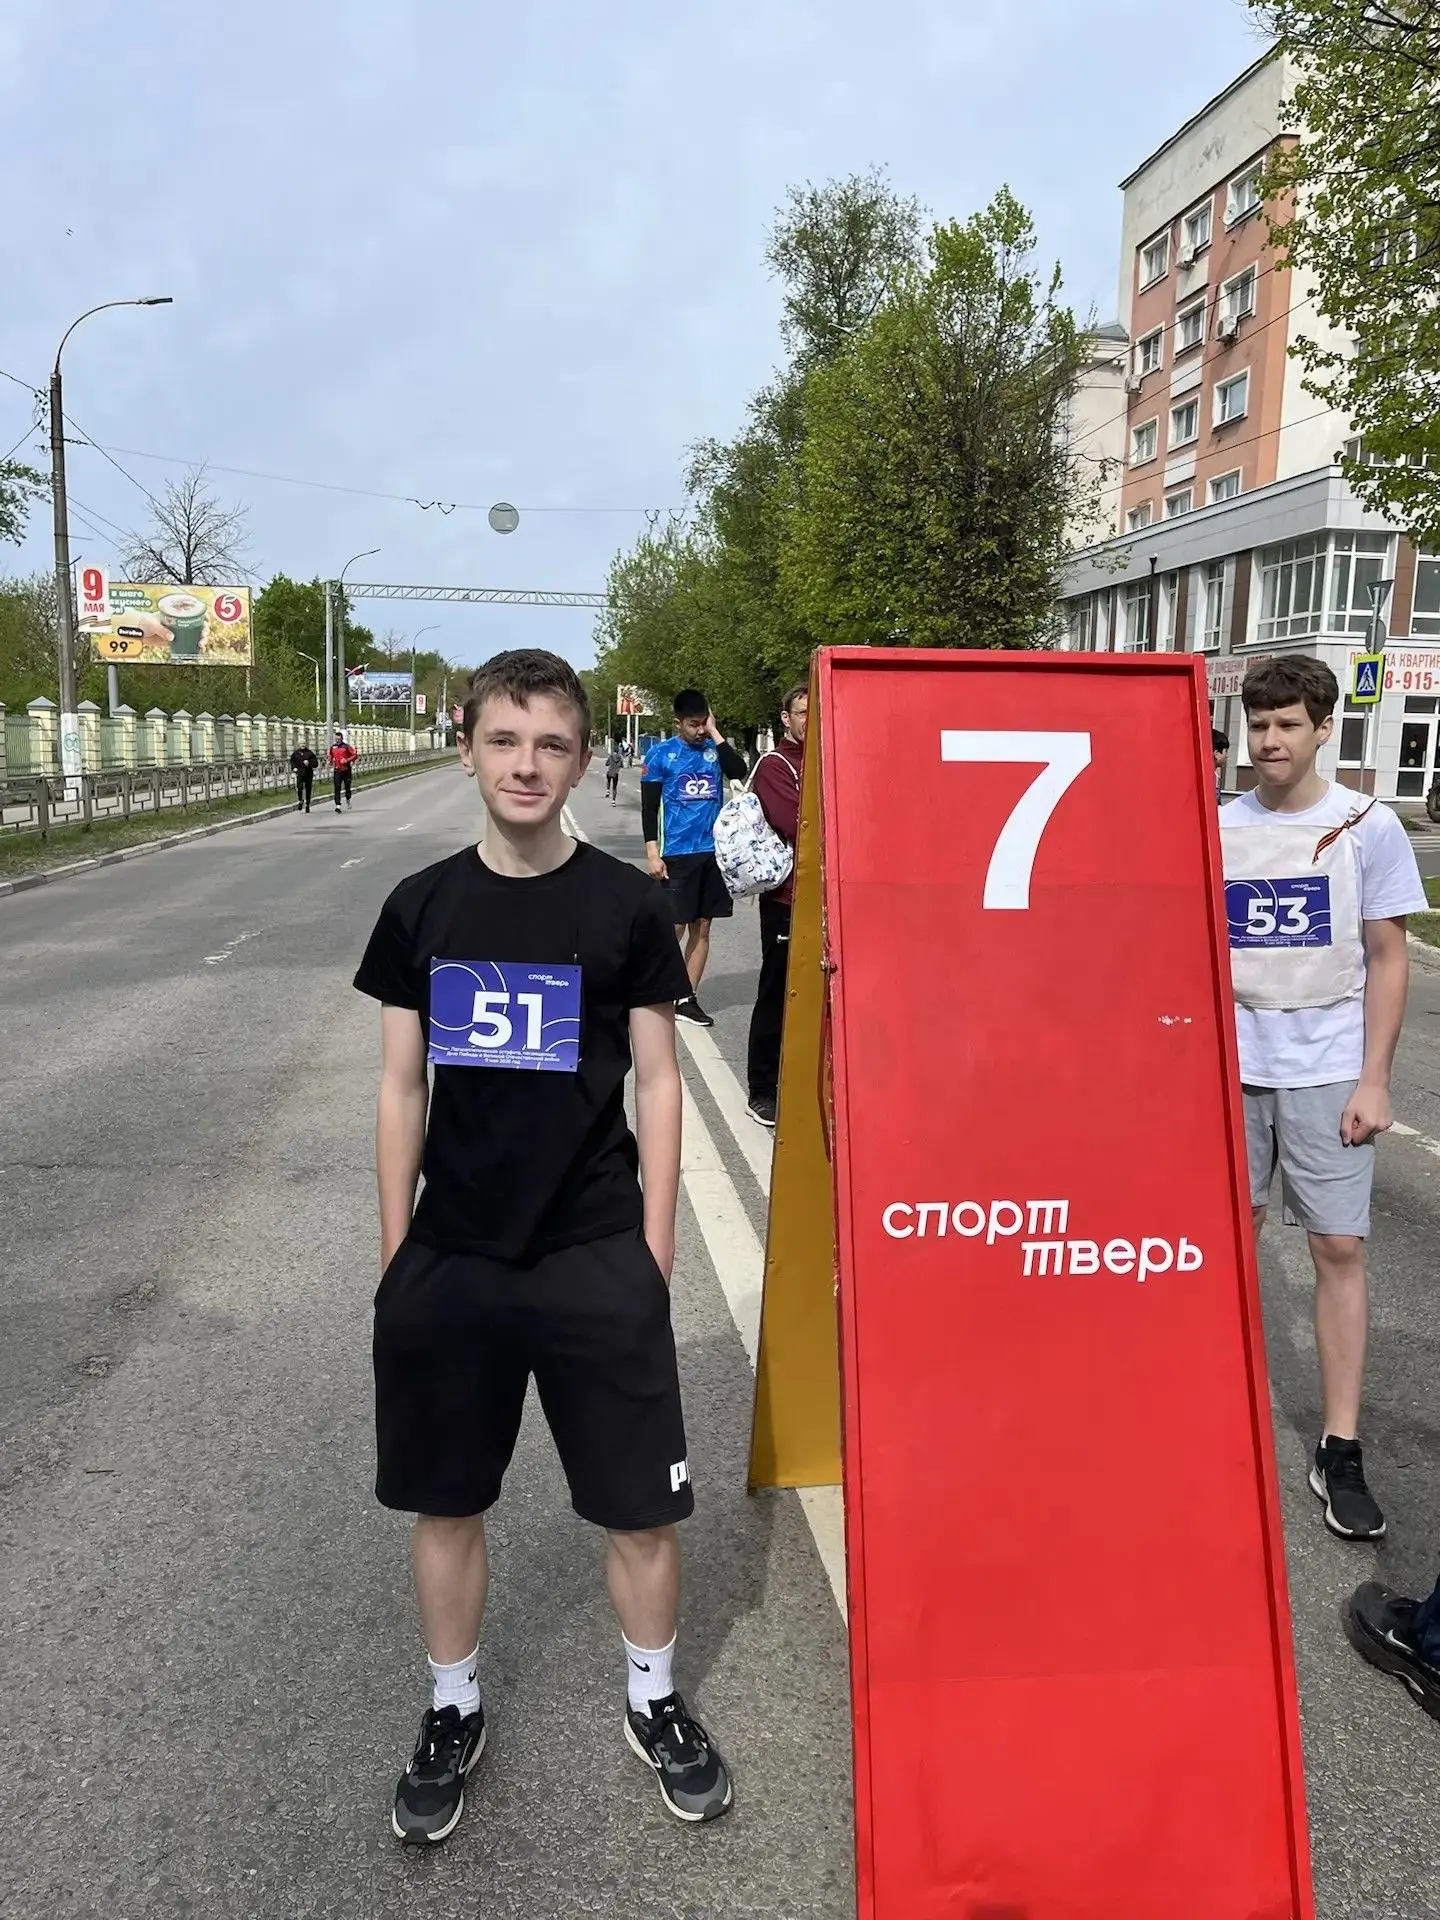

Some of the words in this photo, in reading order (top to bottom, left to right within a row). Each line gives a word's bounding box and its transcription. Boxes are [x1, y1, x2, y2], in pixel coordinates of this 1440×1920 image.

[83, 568, 103, 601] 9
[84, 603, 105, 613] МАЯ
[109, 641, 128, 653] 99
[685, 780, 711, 796] 62
[941, 729, 1092, 910] 7
[1246, 897, 1310, 936] 53
[467, 991, 543, 1050] 51
[882, 1200, 1069, 1245] спорт
[1021, 1237, 1204, 1282] тверь
